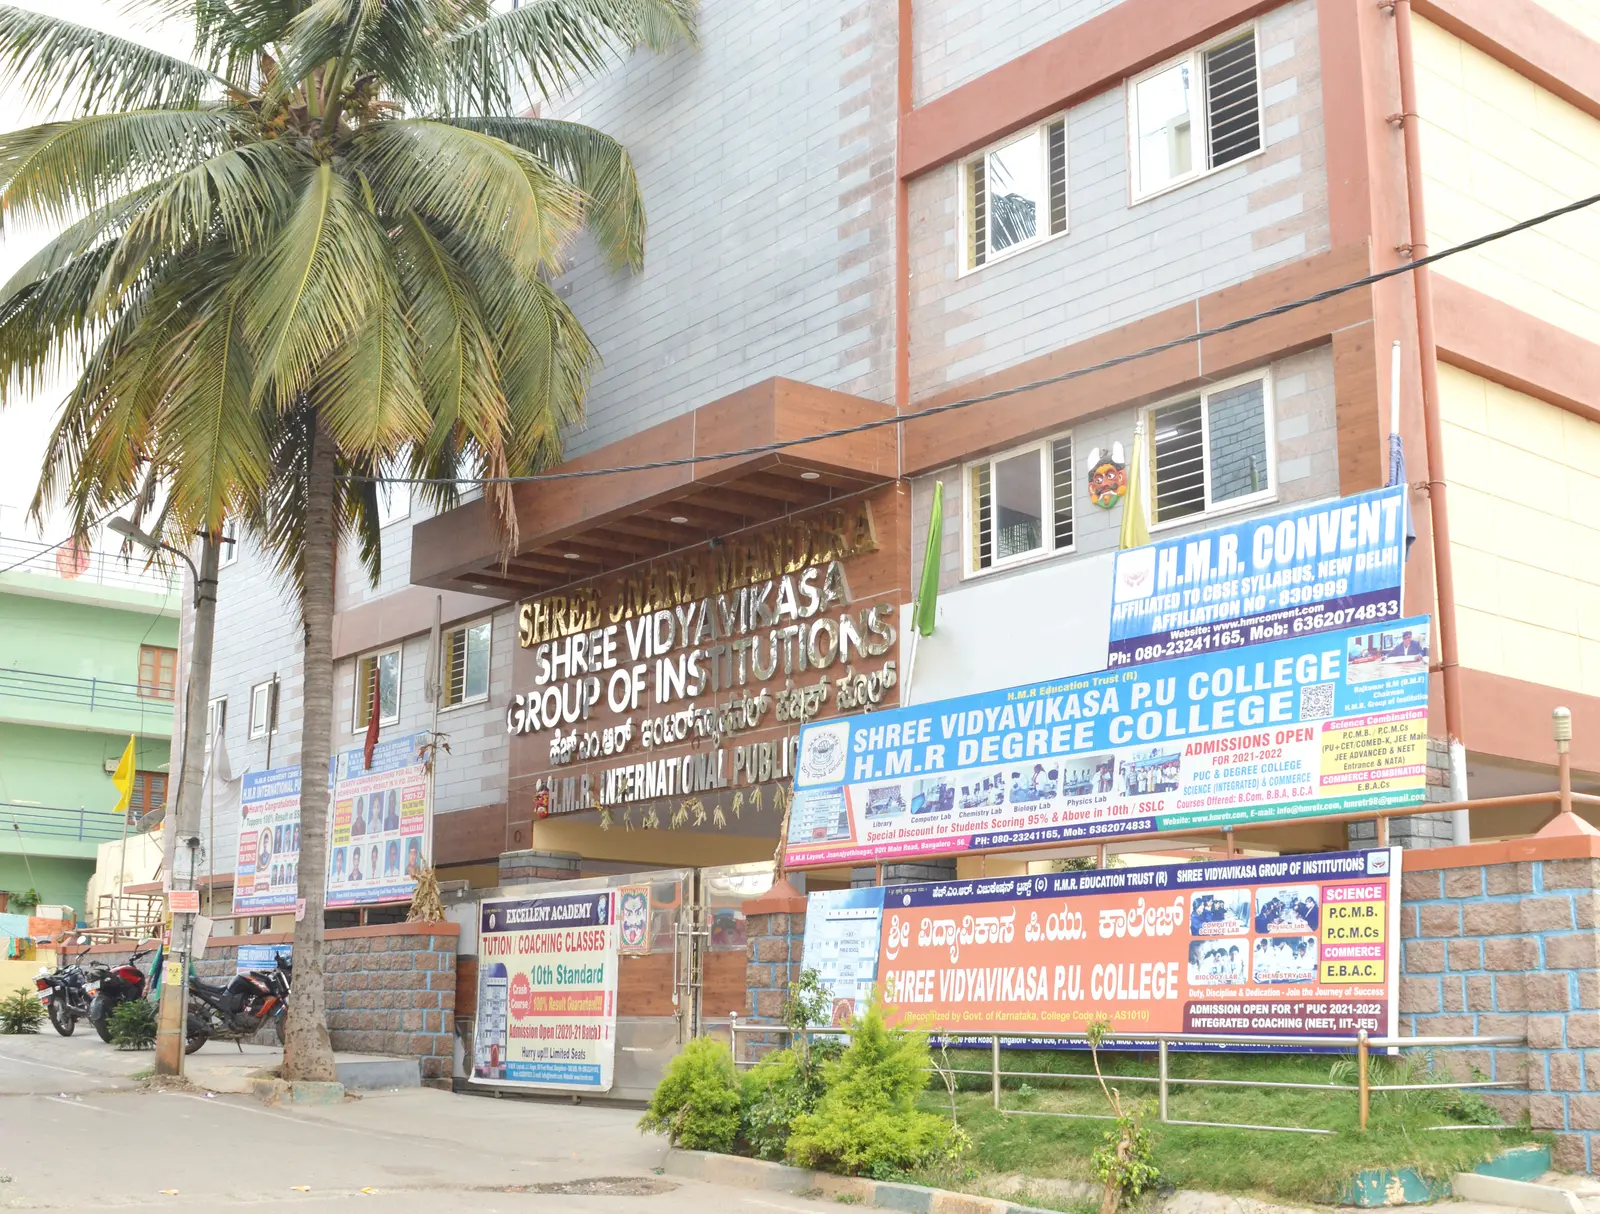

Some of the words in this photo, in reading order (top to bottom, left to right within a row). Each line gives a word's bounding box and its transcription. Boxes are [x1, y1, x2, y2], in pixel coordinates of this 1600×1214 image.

[1158, 533, 1245, 591] H.M.R.
[1252, 495, 1402, 570] CONVENT
[1112, 592, 1181, 622] AFFILIATED
[1183, 588, 1201, 607] TO
[1203, 580, 1239, 602] CBSE
[1240, 564, 1315, 595] SYLLABUS,
[1317, 555, 1353, 580] NEW
[1354, 546, 1399, 572] DELHI
[1151, 600, 1241, 633] AFFILIATION
[1243, 594, 1266, 615] NO
[1278, 578, 1348, 607] 830999
[518, 587, 602, 648] SHREE
[534, 625, 618, 685] SHREE
[624, 560, 851, 661] VIDYAVIKASA
[1170, 625, 1211, 641] Website:
[1213, 604, 1324, 633] www.hmrconvent.com
[1109, 651, 1131, 668] Ph:
[1134, 630, 1245, 662] 080-23241165,
[1249, 622, 1289, 641] Mob:
[1292, 599, 1399, 633] 6362074833
[507, 677, 601, 734] GROUP
[608, 664, 647, 713] OF
[655, 603, 898, 704] INSTITUTIONS
[1007, 688, 1036, 700] H.M.R
[1039, 680, 1089, 696] Education
[1093, 673, 1120, 687] Trust
[1122, 671, 1138, 683] (R)
[853, 718, 932, 752] SHREE
[941, 686, 1121, 739] VIDYAVIKASA
[1131, 677, 1176, 711] P.U
[1188, 649, 1342, 701] COLLEGE
[1329, 719, 1365, 731] Science
[1366, 710, 1423, 725] Combination
[853, 744, 946, 781] H.M.R
[957, 720, 1095, 767] DEGREE
[1108, 690, 1293, 745] COLLEGE
[1185, 733, 1270, 757] ADMISSIONS
[1275, 727, 1314, 745] OPEN
[1393, 734, 1407, 743] JEE
[1213, 756, 1230, 766] FOR
[1232, 748, 1282, 763] 2021-2022
[1334, 753, 1348, 762] JEE
[1349, 747, 1387, 760] ADVANCED
[1397, 744, 1416, 753] NEET
[600, 749, 726, 805] INTERNATIONAL
[732, 735, 800, 783] PUBLIC
[1193, 771, 1211, 782] PUC
[1224, 764, 1258, 777] DEGREE
[1261, 759, 1302, 774] COLLEGE
[1343, 760, 1375, 771] Entrance
[1384, 756, 1406, 767] NATA)
[1183, 784, 1211, 796] SCIENCE
[1214, 779, 1260, 794] (INTEGRATED)
[1269, 772, 1311, 787] COMMERCE
[1322, 774, 1369, 785] COMMERCE
[1067, 798, 1092, 808] Physics
[1176, 799, 1205, 810] Courses
[1207, 794, 1236, 806] Offered:
[1292, 785, 1313, 797] B.C.A
[911, 814, 939, 825] Computer
[959, 809, 989, 820] Chemistry
[1014, 804, 1037, 815] Biology
[867, 827, 896, 843] Special
[898, 824, 935, 838] Discount
[937, 823, 949, 835] for
[950, 819, 989, 834] Students
[991, 815, 1025, 831] Scoring
[1027, 813, 1049, 826] 95%
[1061, 808, 1091, 822] Above
[1093, 808, 1103, 819] in
[1106, 804, 1129, 817] 10th
[1138, 800, 1165, 813] SSLC
[873, 821, 893, 833] Library
[1162, 816, 1191, 826] Website:
[974, 835, 990, 846] PH:
[992, 828, 1061, 844] 080-23241165,
[1063, 825, 1087, 838] Mob:
[1089, 820, 1152, 835] 6362074833
[1176, 869, 1203, 882] SHREE
[1204, 865, 1258, 881] VIDYAVIKASA
[1258, 862, 1289, 877] GROUP
[1289, 861, 1302, 875] OF
[1302, 857, 1365, 875] INSTITUTIONS
[1054, 878, 1078, 891] H.M.R.
[1079, 874, 1125, 890] EDUCATION
[1126, 872, 1154, 886] TRUST
[1155, 871, 1168, 887] (R)
[1326, 886, 1382, 901] SCIENCE
[506, 907, 550, 924] EXCELLENT
[551, 902, 593, 920] ACADEMY
[1329, 906, 1378, 918] P.C.M.B.
[1202, 921, 1237, 929] COMPUTER
[1266, 922, 1294, 932] Physics
[1327, 926, 1379, 939] P.C.M.Cs
[483, 936, 512, 956] TUTION
[518, 932, 562, 955] COACHING
[565, 930, 606, 953] CLASSES
[885, 914, 910, 960] ಶ್ರೀ
[1324, 946, 1382, 958] COMMERCE
[530, 965, 553, 985] 10th
[556, 962, 604, 985] Standard
[1258, 972, 1296, 980] CHEMISTRY
[1327, 965, 1377, 977] E.B.A.C.
[883, 969, 934, 1003] SHREE
[939, 965, 1048, 1002] VIDYAVIKASA
[1054, 964, 1085, 1001] P.U.
[1090, 961, 1179, 1001] COLLEGE
[1206, 988, 1237, 999] Discipline
[1245, 988, 1280, 997] Dedication
[1315, 987, 1343, 999] Journey
[1353, 987, 1384, 996] Success
[951, 1011, 961, 1023] by
[995, 1010, 1038, 1022] Karnataka,
[1041, 1010, 1070, 1022] College
[1072, 1010, 1093, 1020] Code
[1113, 1010, 1150, 1022] AS1010)
[1189, 1004, 1242, 1015] ADMISSION
[1243, 1004, 1269, 1015] OPEN
[1271, 1004, 1292, 1014] FOR
[1306, 1004, 1328, 1014] PUC
[1329, 1004, 1381, 1014] 2021-2022
[509, 1023, 538, 1040] Admission
[539, 1023, 554, 1041] Open
[1191, 1018, 1249, 1028] INTEGRATED
[1251, 1018, 1303, 1028] COACHING
[1304, 1018, 1336, 1030] (NEET,
[1339, 1017, 1379, 1031] IIT-JEE)
[550, 1047, 570, 1060] Limited
[571, 1048, 586, 1060] Seats
